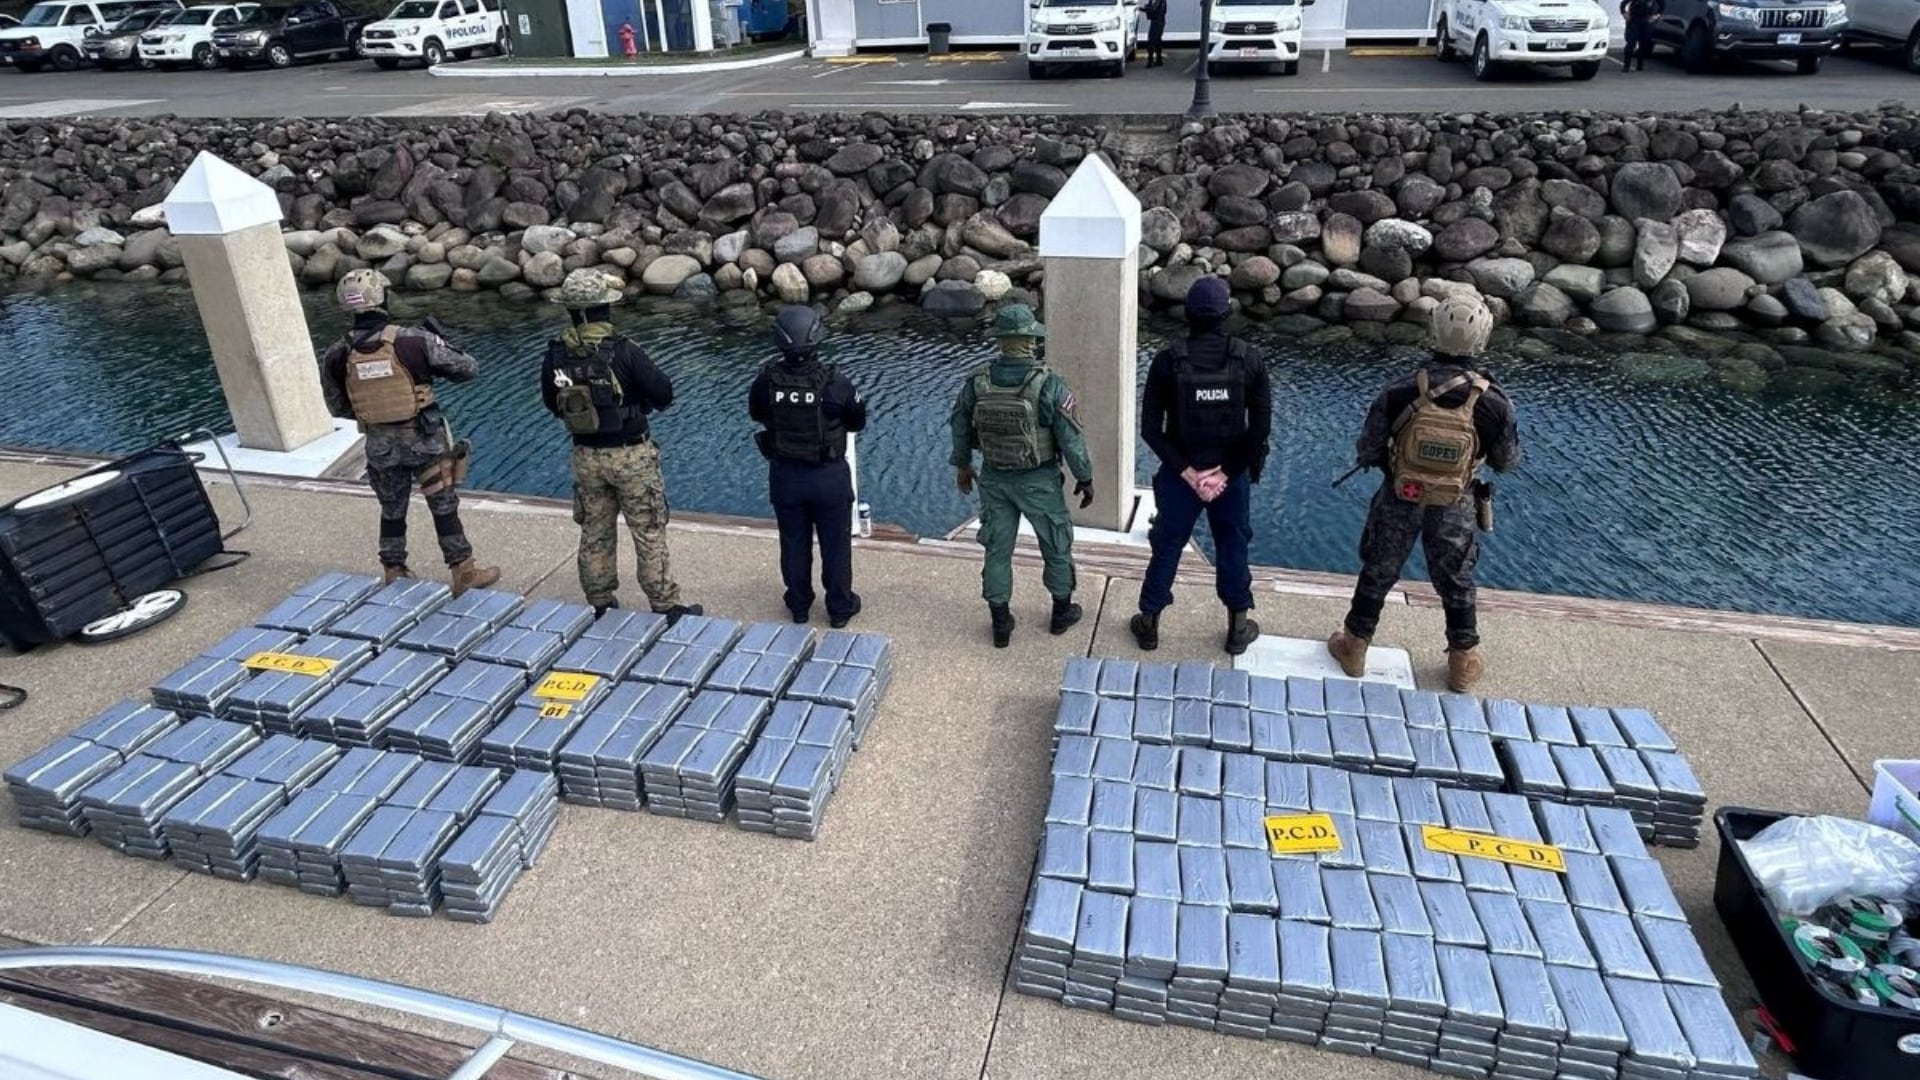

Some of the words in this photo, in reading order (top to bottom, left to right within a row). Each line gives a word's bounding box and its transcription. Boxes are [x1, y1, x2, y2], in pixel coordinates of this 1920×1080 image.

[452, 24, 486, 38] POLICIA
[1196, 388, 1229, 401] POLICIA
[545, 706, 562, 717] 01
[1271, 825, 1337, 841] P.C.D.
